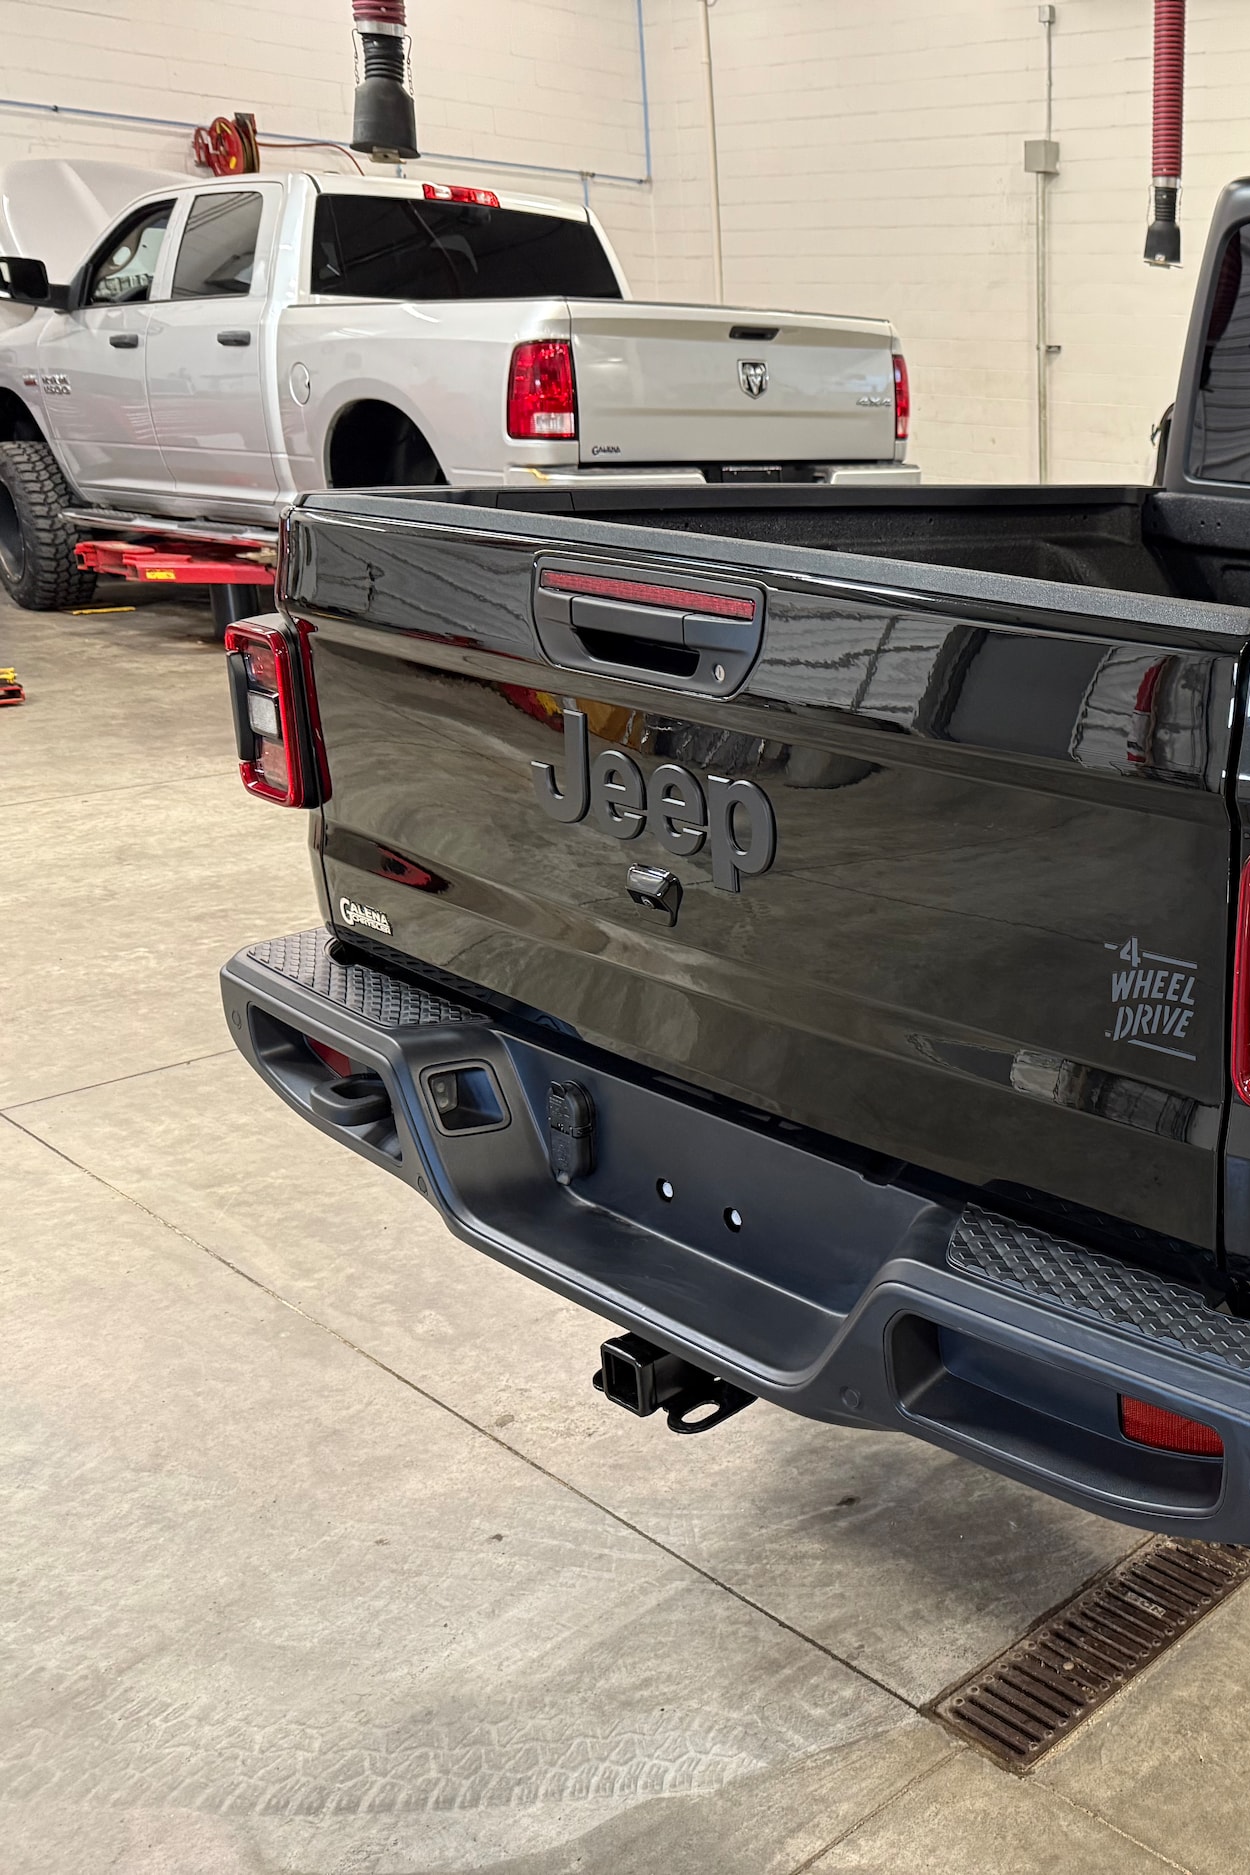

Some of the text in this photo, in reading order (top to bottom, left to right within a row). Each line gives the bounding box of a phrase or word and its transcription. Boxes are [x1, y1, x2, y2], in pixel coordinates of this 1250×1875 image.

[531, 708, 777, 893] Jeep
[340, 897, 389, 926] GALENA
[1111, 969, 1196, 1006] WHEEL
[1113, 1003, 1195, 1042] DRIVE
